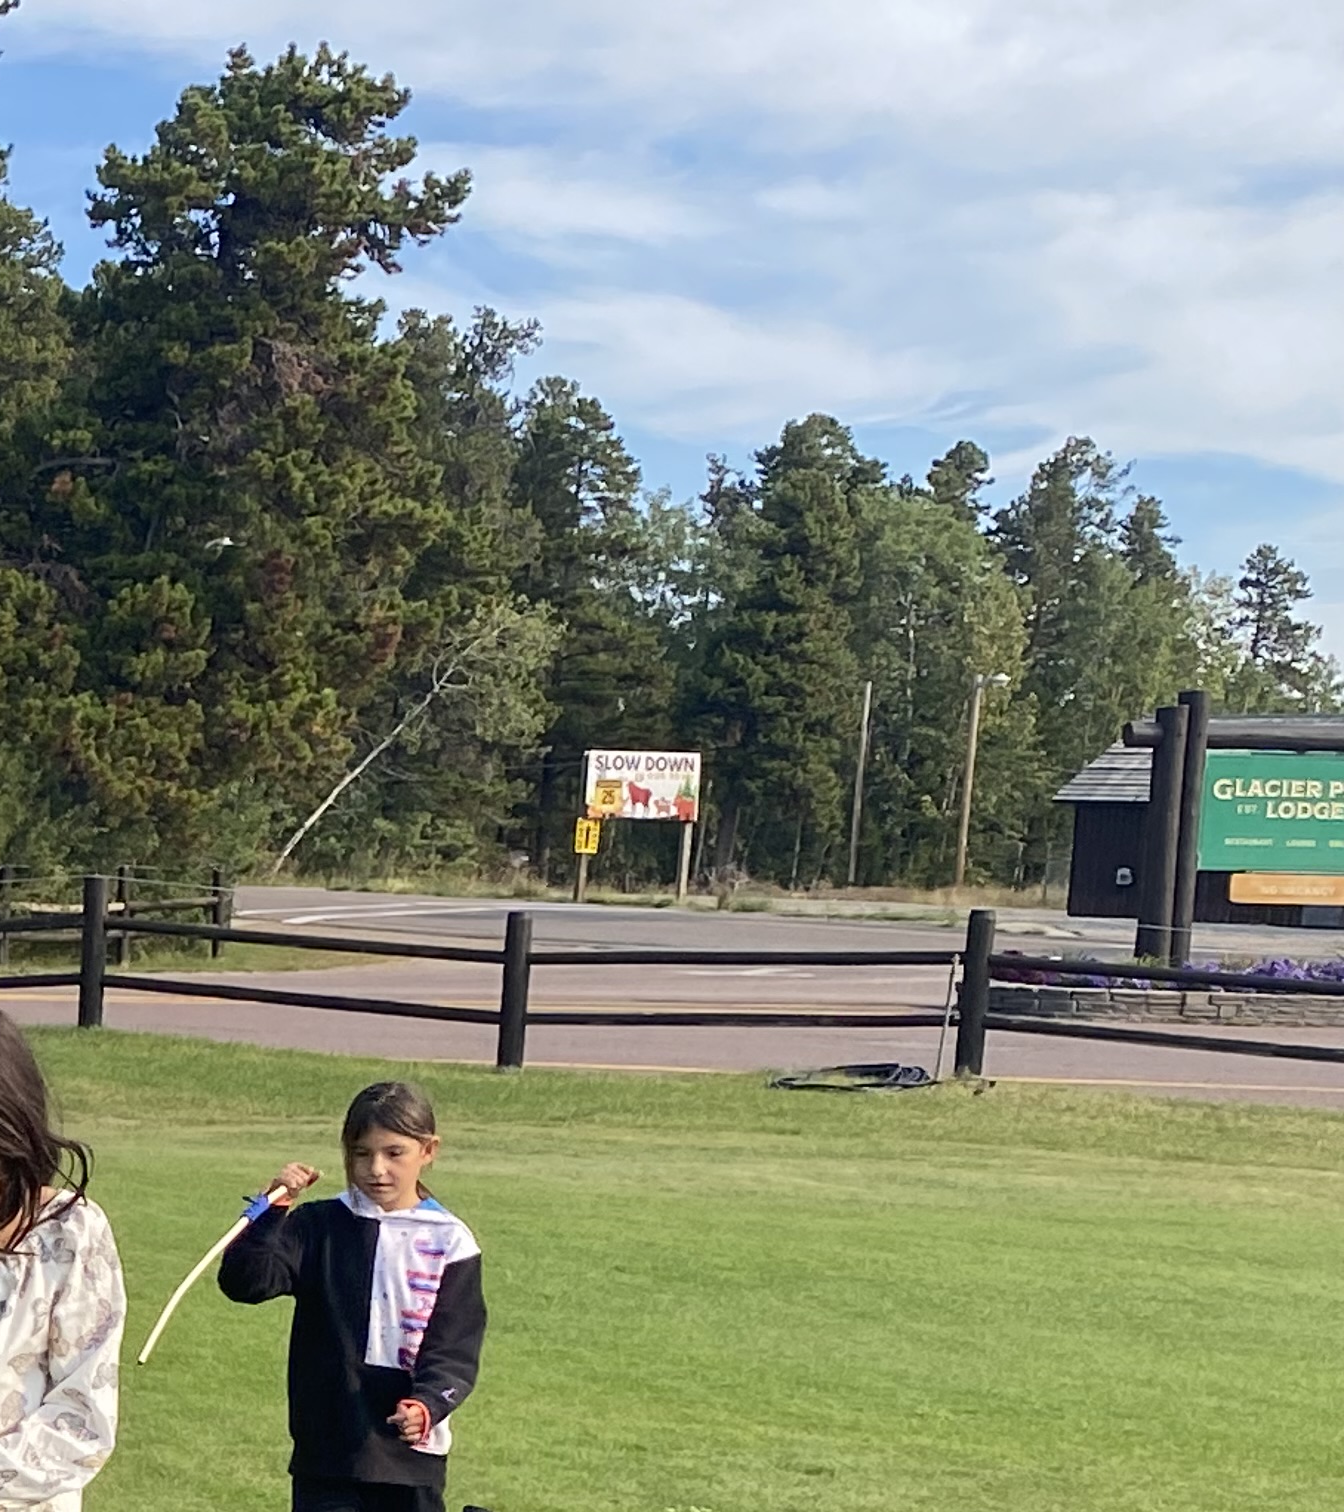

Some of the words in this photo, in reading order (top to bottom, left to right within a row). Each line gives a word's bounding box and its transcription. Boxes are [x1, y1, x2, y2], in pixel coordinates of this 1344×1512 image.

[595, 755, 641, 771] SLOW
[645, 756, 694, 772] DOWN
[602, 789, 615, 804] 25
[1213, 778, 1323, 800] GLACIER
[1266, 801, 1344, 820] LODGE
